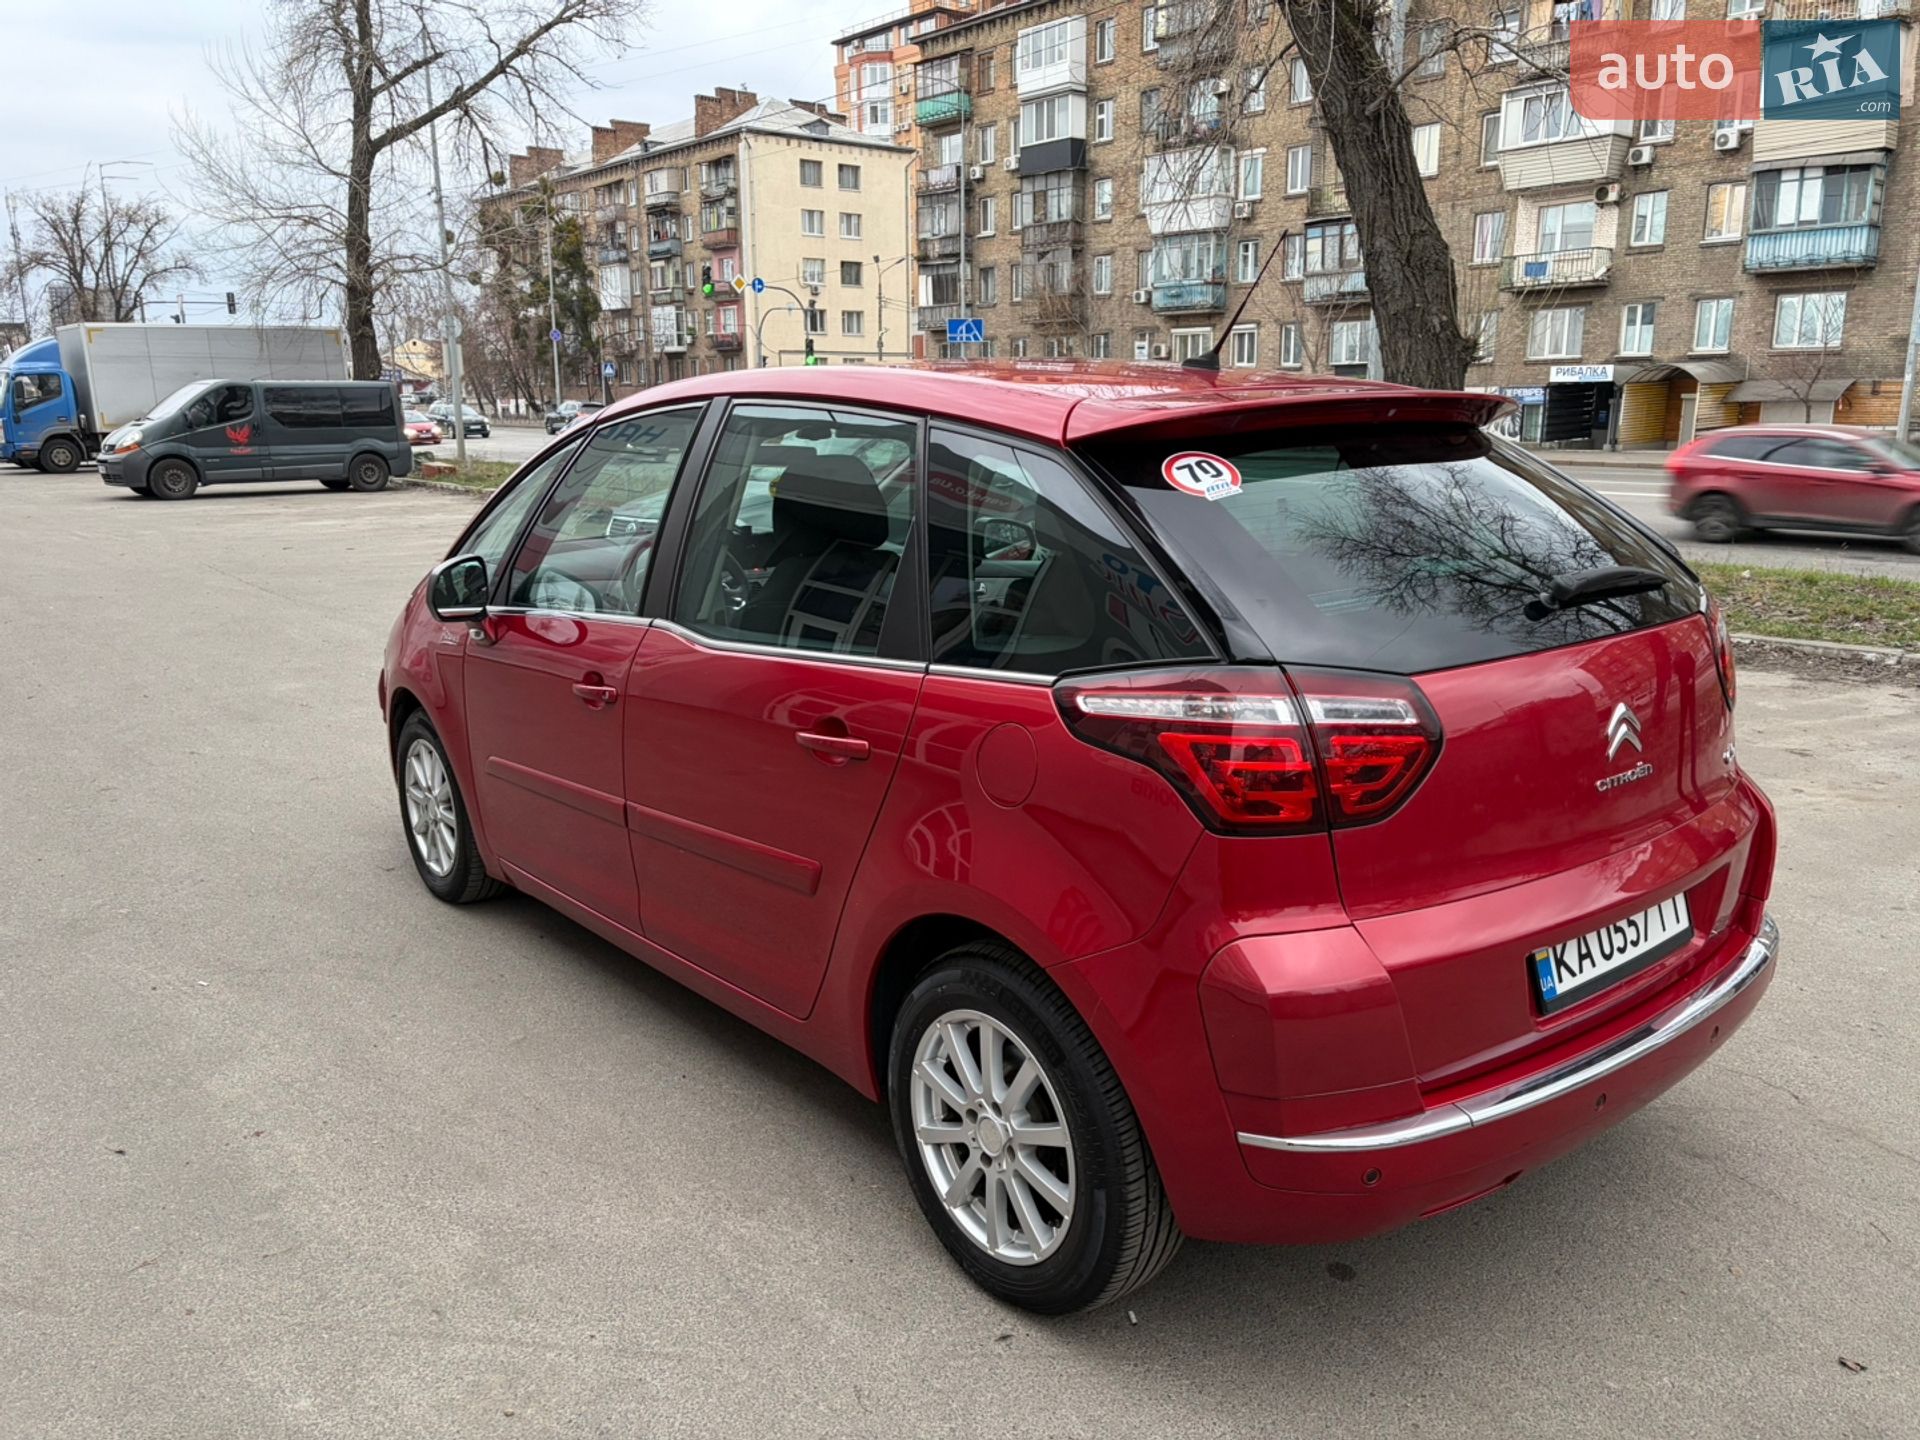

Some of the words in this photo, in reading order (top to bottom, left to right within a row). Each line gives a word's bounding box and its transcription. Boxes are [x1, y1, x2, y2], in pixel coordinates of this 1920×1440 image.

[1555, 366, 1608, 378] РИБАЛКА
[1594, 761, 1654, 792] CITROËN
[1540, 975, 1554, 991] UA
